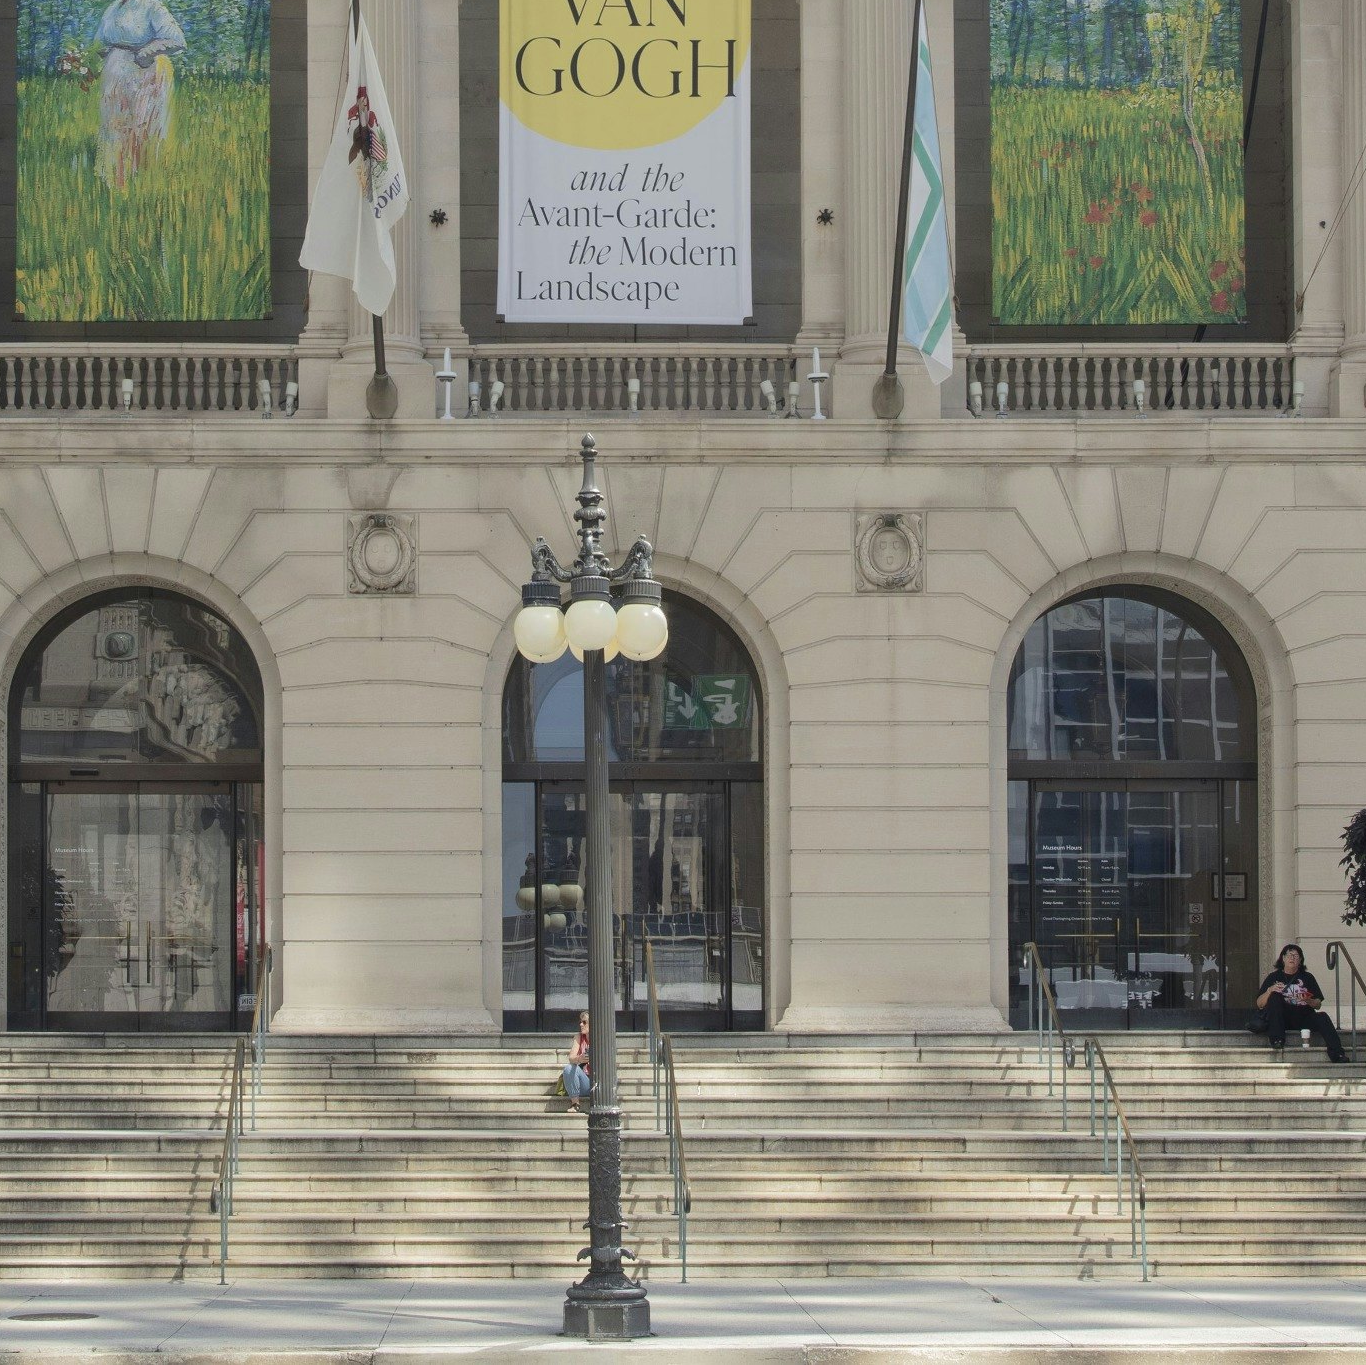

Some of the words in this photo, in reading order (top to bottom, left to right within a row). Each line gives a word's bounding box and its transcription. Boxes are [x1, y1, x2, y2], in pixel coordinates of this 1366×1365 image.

[514, 36, 738, 99] GOGH
[570, 163, 630, 193] and
[641, 163, 685, 193] the
[517, 196, 718, 230] Avant-Garde:
[568, 235, 612, 266] the
[619, 235, 739, 267] Modern
[515, 270, 681, 310] Landscape
